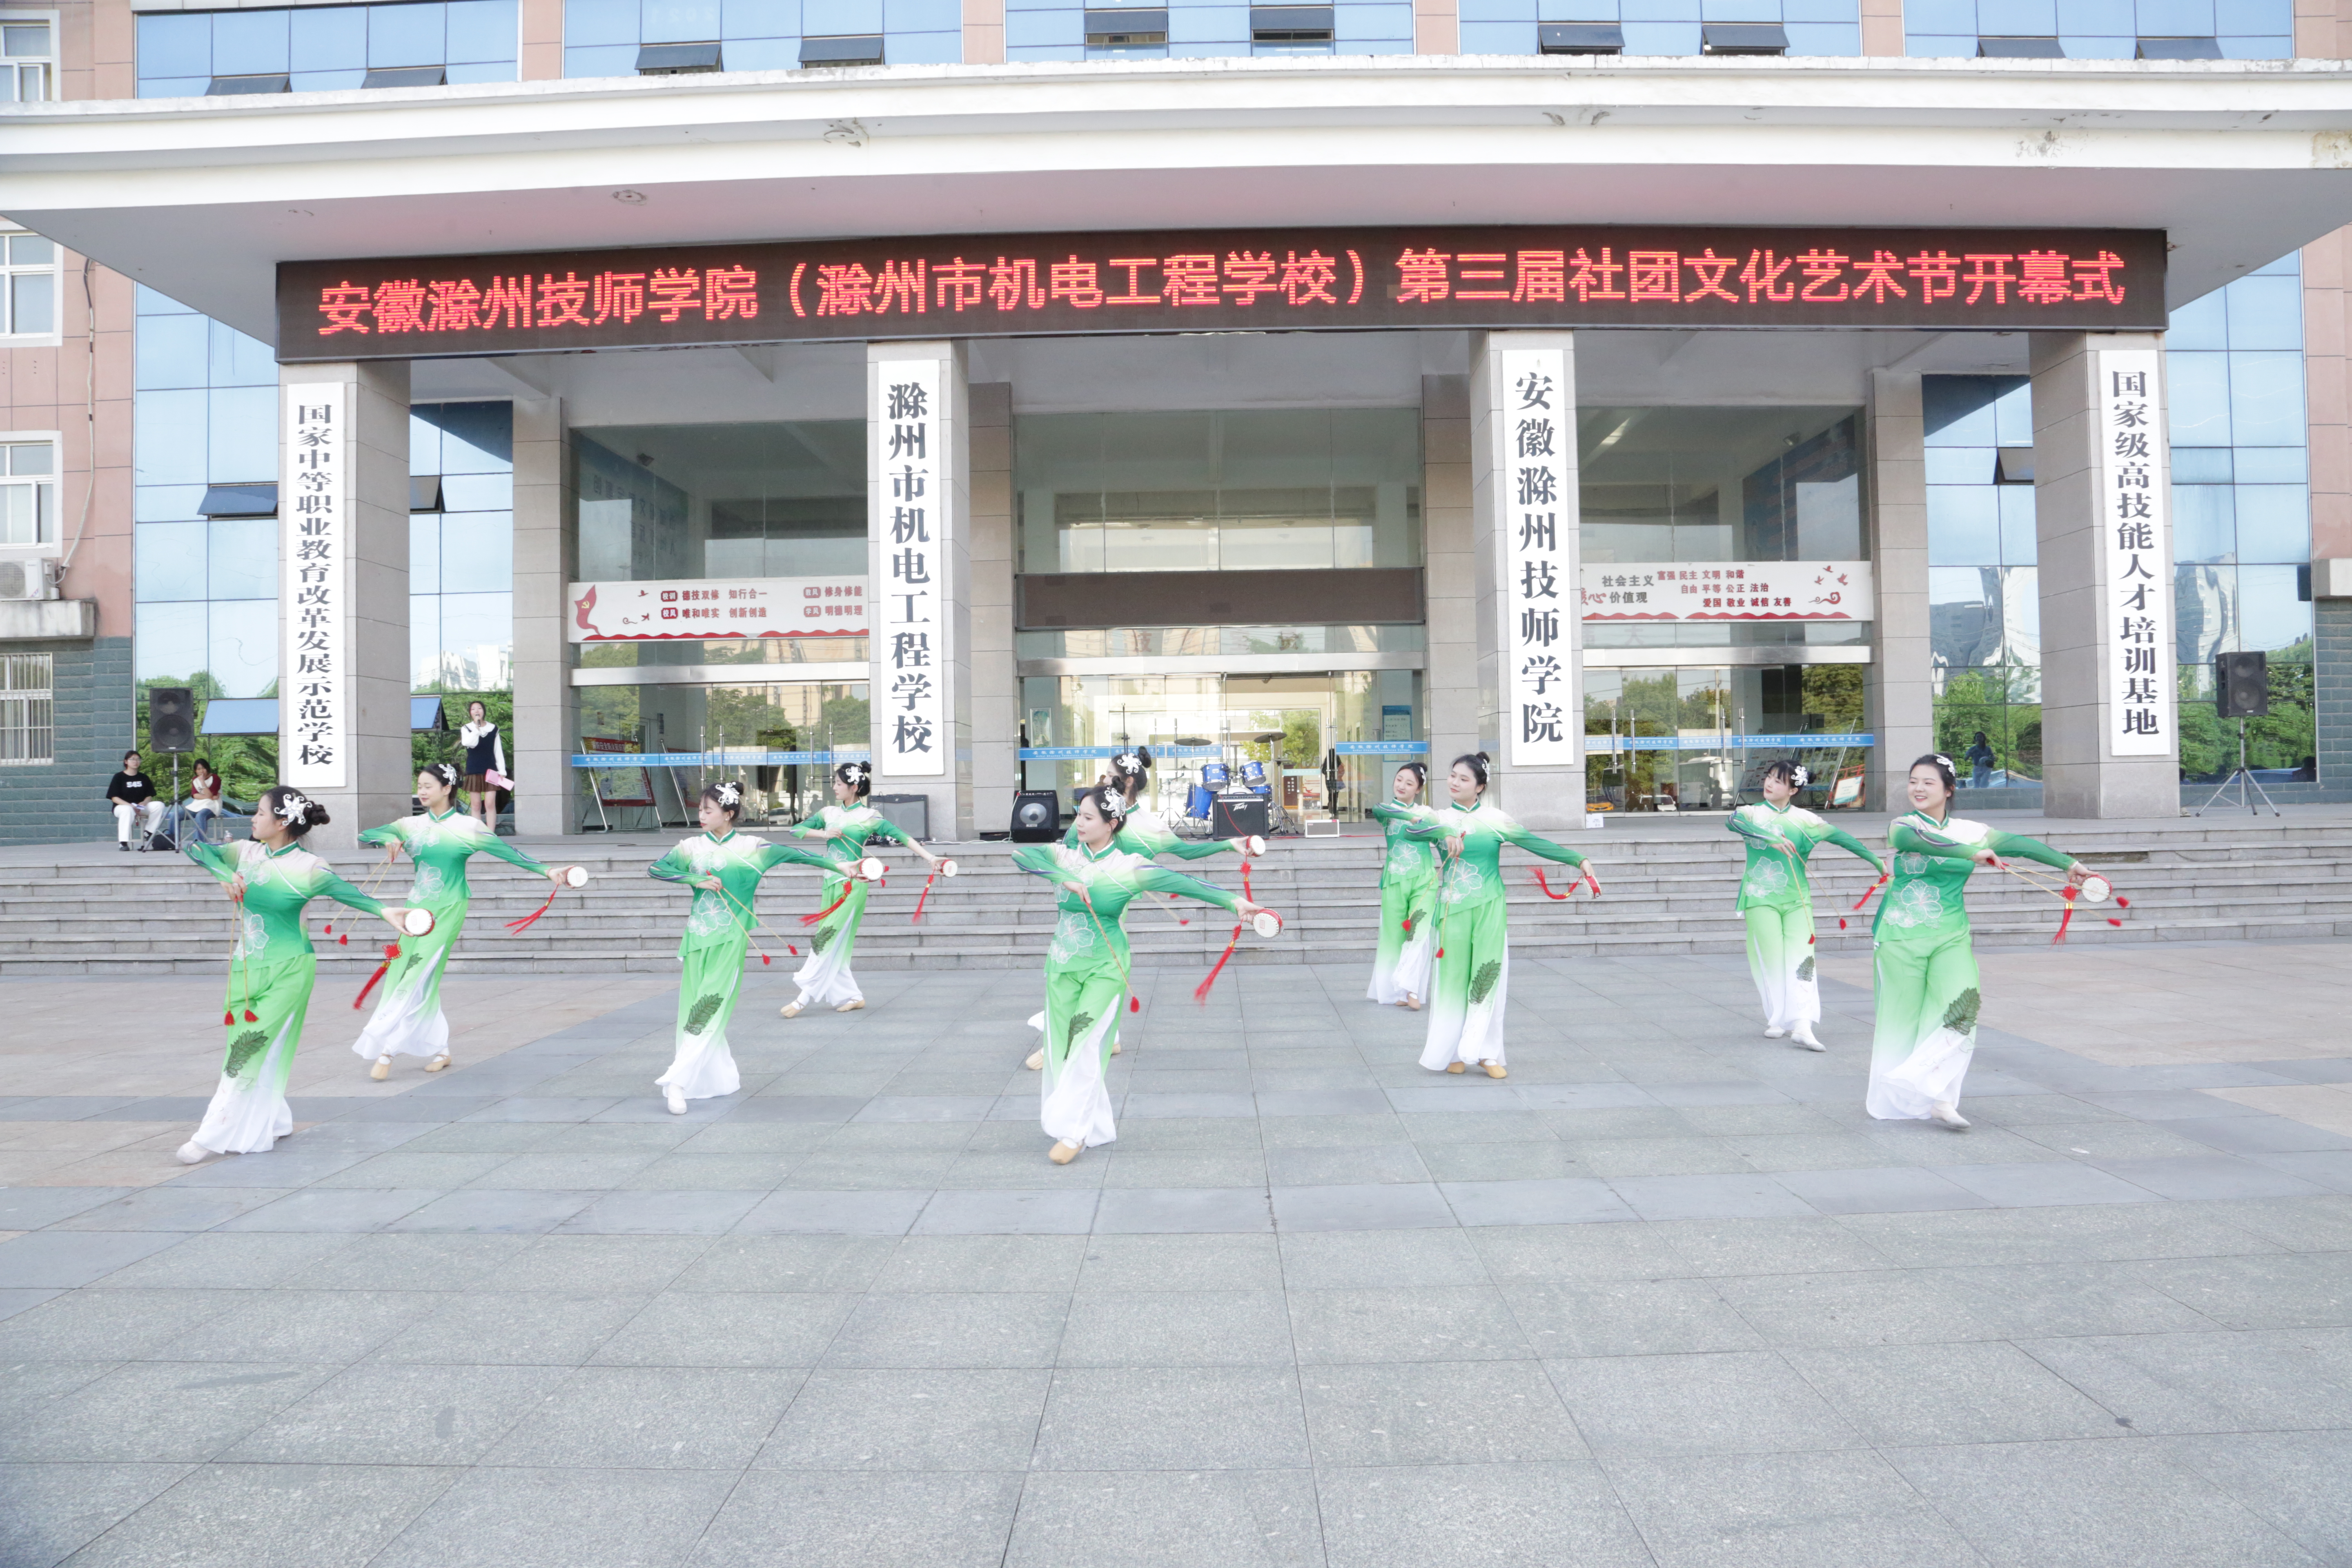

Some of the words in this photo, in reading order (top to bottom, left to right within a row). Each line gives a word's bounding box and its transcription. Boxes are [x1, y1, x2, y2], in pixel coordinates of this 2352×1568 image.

[1516, 372, 1563, 744] 安徽滁州技师学院
[2112, 371, 2160, 735] 国家级高技能人才培训基地
[887, 382, 933, 753] 滁州市机电工程学校
[1657, 570, 1676, 580] 富强
[1679, 571, 1697, 580] 民主
[1702, 570, 1720, 579] 文明
[1726, 569, 1744, 579] 和谐
[296, 404, 333, 765] 国家中等职业教育改革发展示范学校
[1602, 575, 1654, 587] 社会主义
[825, 586, 862, 597] 修身修能
[1681, 584, 1697, 594] 自由
[1702, 584, 1721, 593] 平等
[1726, 584, 1745, 592] 公正
[1750, 583, 1769, 592] 法治
[662, 592, 676, 600] 校训
[682, 589, 719, 601] 德技双修
[729, 588, 767, 599] 知行合一
[1703, 598, 1722, 608] 爱国
[1727, 598, 1745, 607] 敬业
[1751, 598, 1769, 607] 诚信
[1774, 597, 1792, 606] 友善
[662, 608, 676, 617] 校风
[682, 608, 719, 618] 唯和唯实
[729, 607, 767, 618] 创新创造
[825, 605, 862, 616] 明德明理
